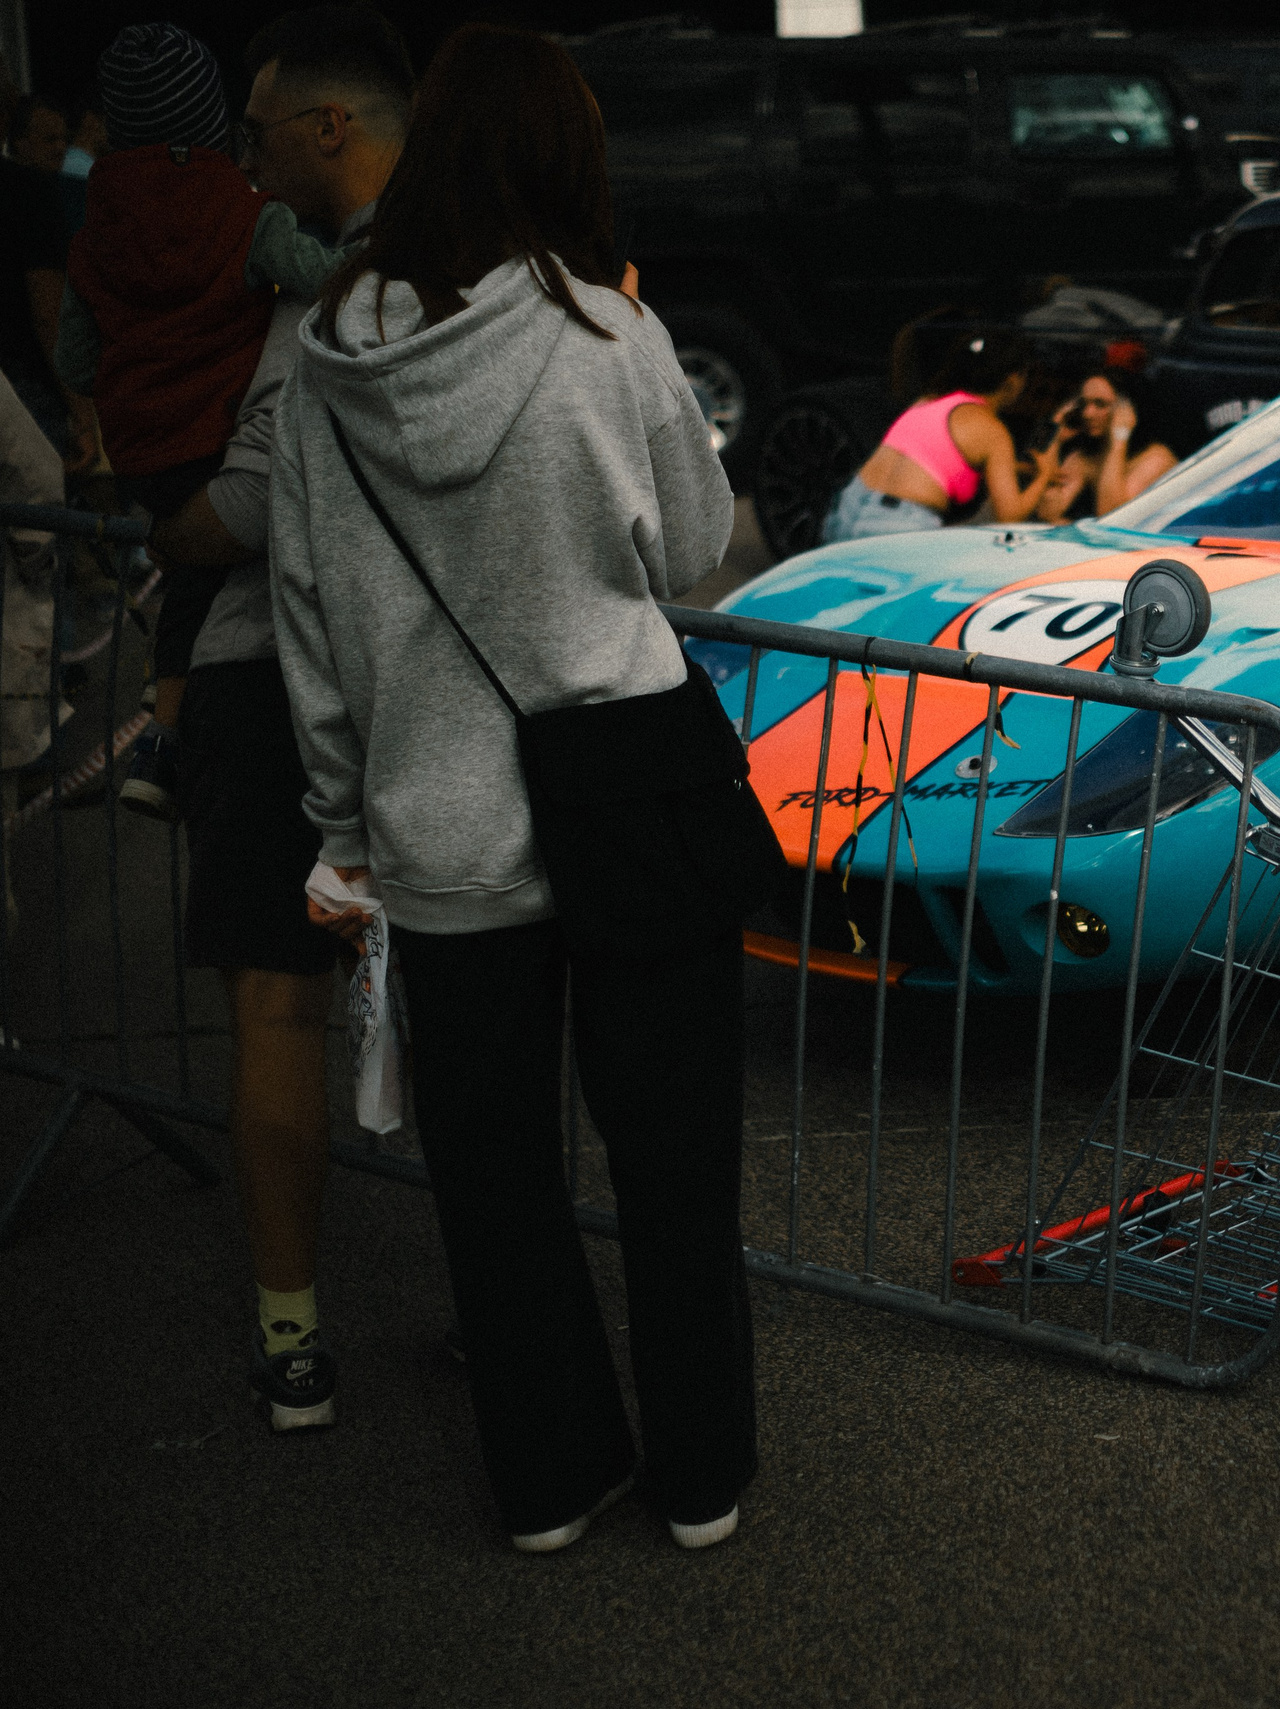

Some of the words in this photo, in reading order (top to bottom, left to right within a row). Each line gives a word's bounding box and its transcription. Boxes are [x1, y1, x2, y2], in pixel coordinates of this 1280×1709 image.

[990, 594, 1122, 640] 70
[291, 1359, 314, 1370] NIKE
[293, 1379, 313, 1387] AIR
